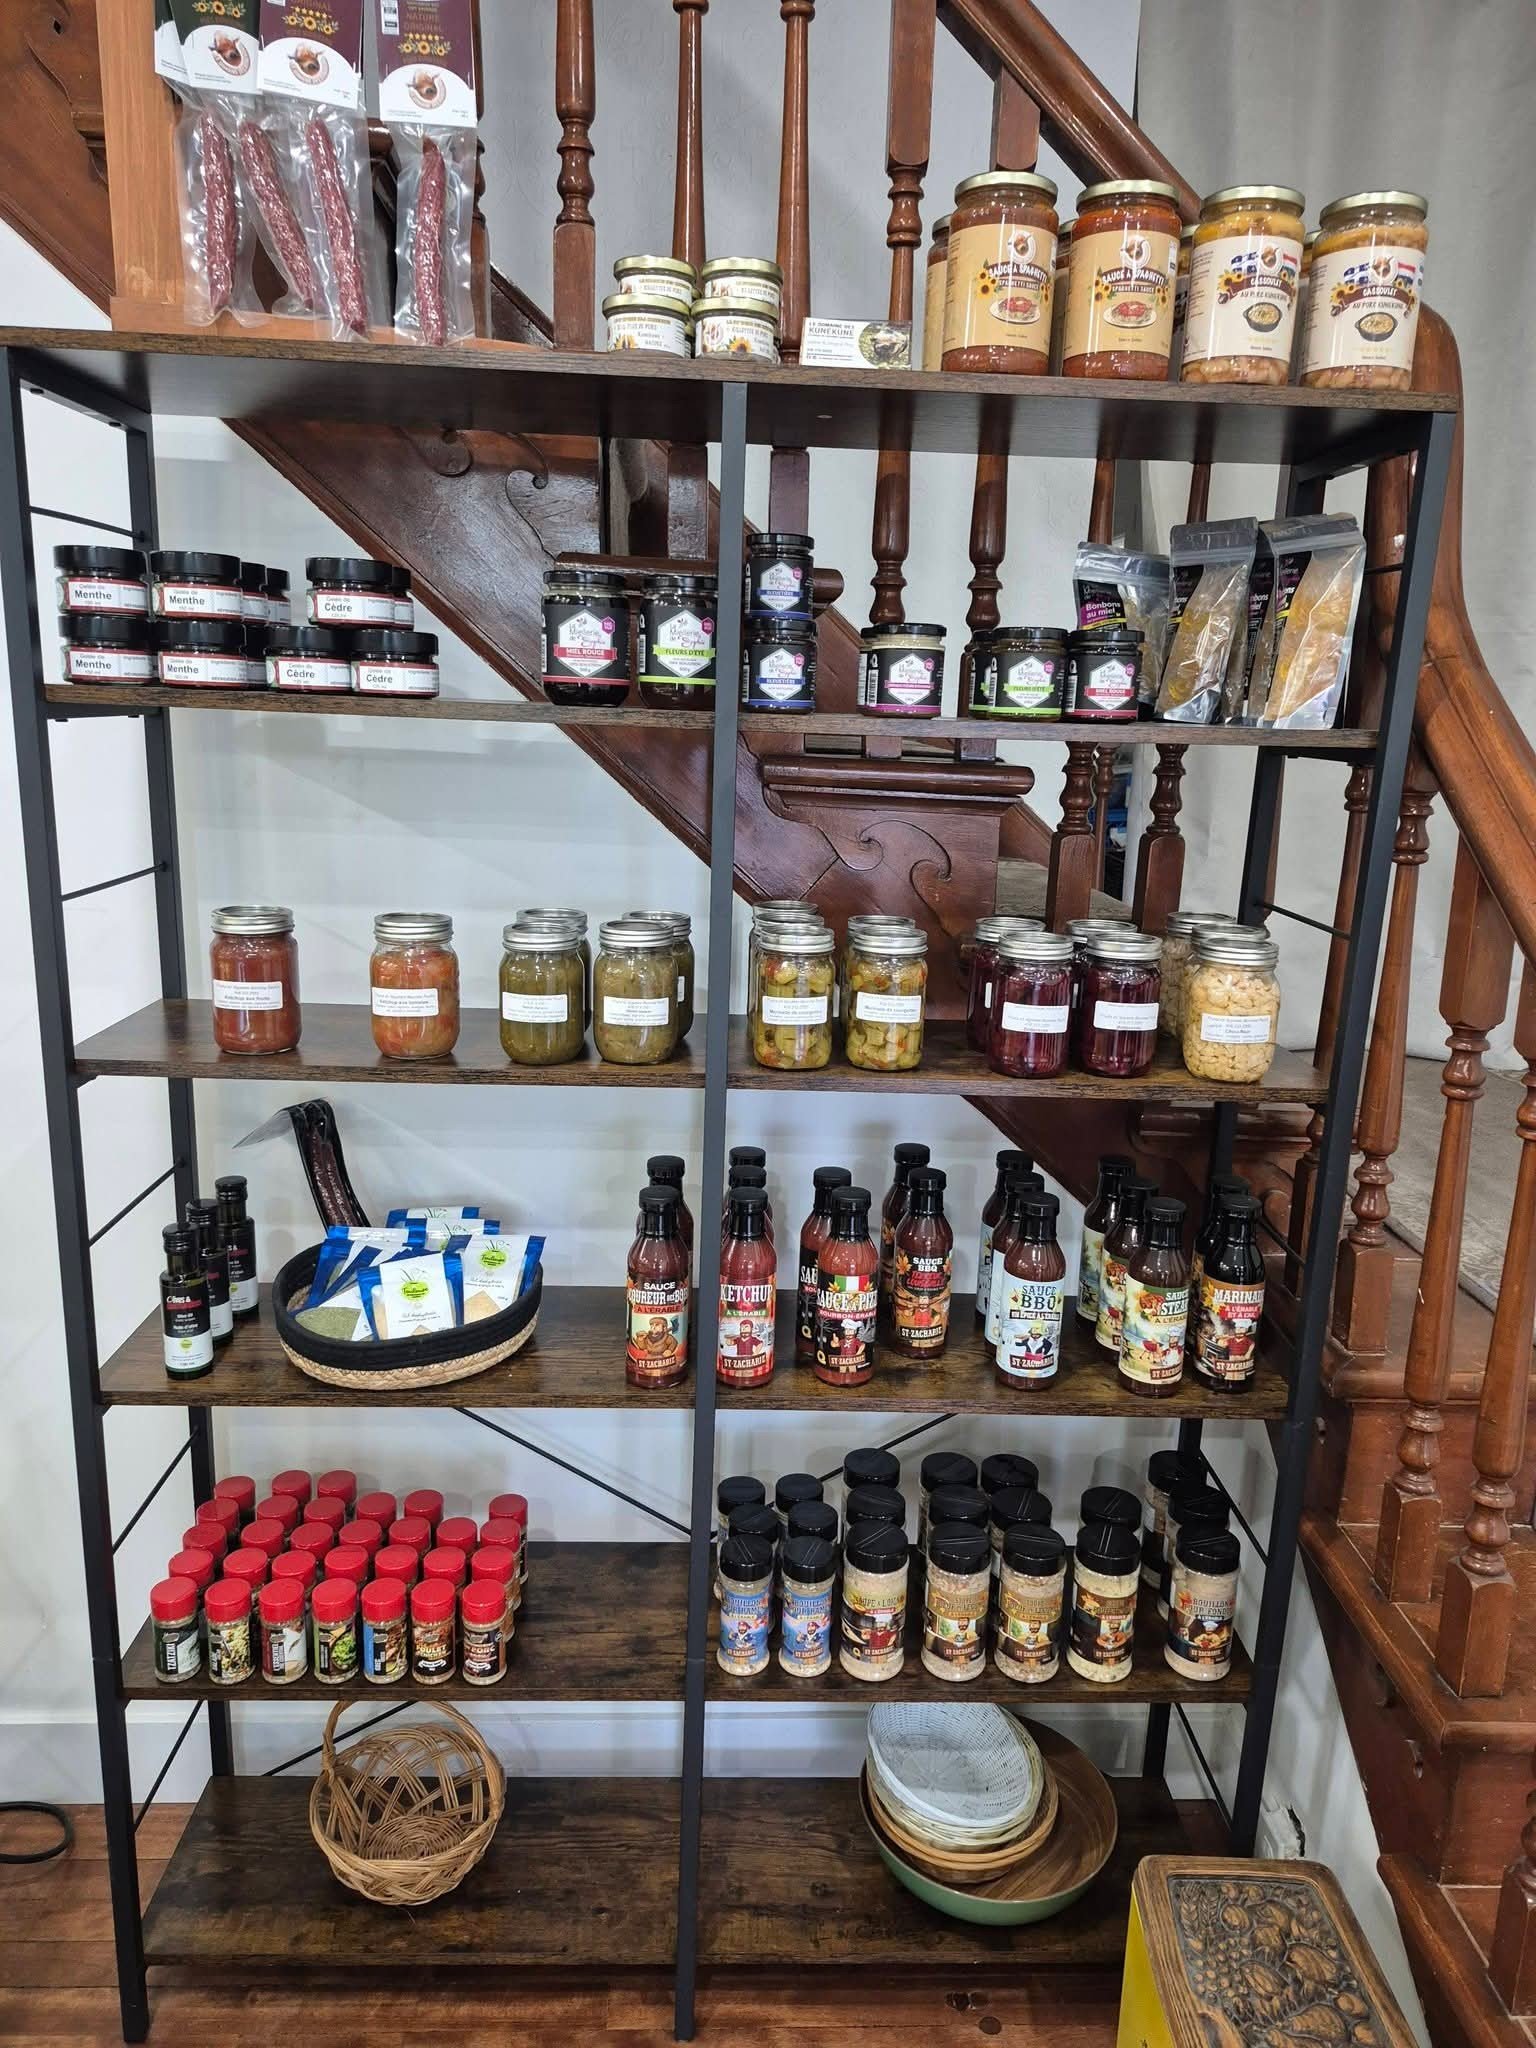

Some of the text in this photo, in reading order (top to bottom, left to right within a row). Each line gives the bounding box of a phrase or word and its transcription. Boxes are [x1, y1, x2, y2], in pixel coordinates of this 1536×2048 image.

[989, 263, 1012, 278] SAUCE
[1019, 264, 1048, 283] SPAGHETTI
[1102, 268, 1126, 284] SAUCE
[1133, 268, 1165, 287] SPAGHETTI
[1250, 276, 1282, 288] CASSOULET
[1362, 285, 1398, 297] CASSOULET
[808, 327, 854, 336] KUNEKUNE
[75, 590, 112, 600] Menthe
[169, 596, 205, 606] Menthe
[1086, 601, 1121, 611] Bonbons
[324, 602, 352, 612] Cèdre
[1098, 607, 1116, 616] miel
[566, 648, 605, 656] MIEL ROUGE
[665, 648, 688, 656] FLEURS
[75, 659, 112, 670] Menthe
[167, 664, 199, 674] Menthe
[286, 668, 315, 679] Cèdre
[366, 674, 393, 684] Cèdre
[912, 1256, 943, 1266] SAUCE
[918, 1264, 938, 1272] BBQ
[800, 1265, 818, 1283] SAU
[644, 1282, 676, 1291] SAUCE
[1022, 1285, 1056, 1296] SAUCE
[628, 1289, 666, 1305] COUREUR
[720, 1284, 773, 1302] KETCHUP
[816, 1289, 849, 1312] SAUCE
[1020, 1294, 1056, 1310] BBQ
[902, 1326, 943, 1338] ST-ZACHARIE
[1193, 1599, 1229, 1608] BOUILLON
[416, 1644, 448, 1654] POULET
[470, 1645, 496, 1654] PORC
